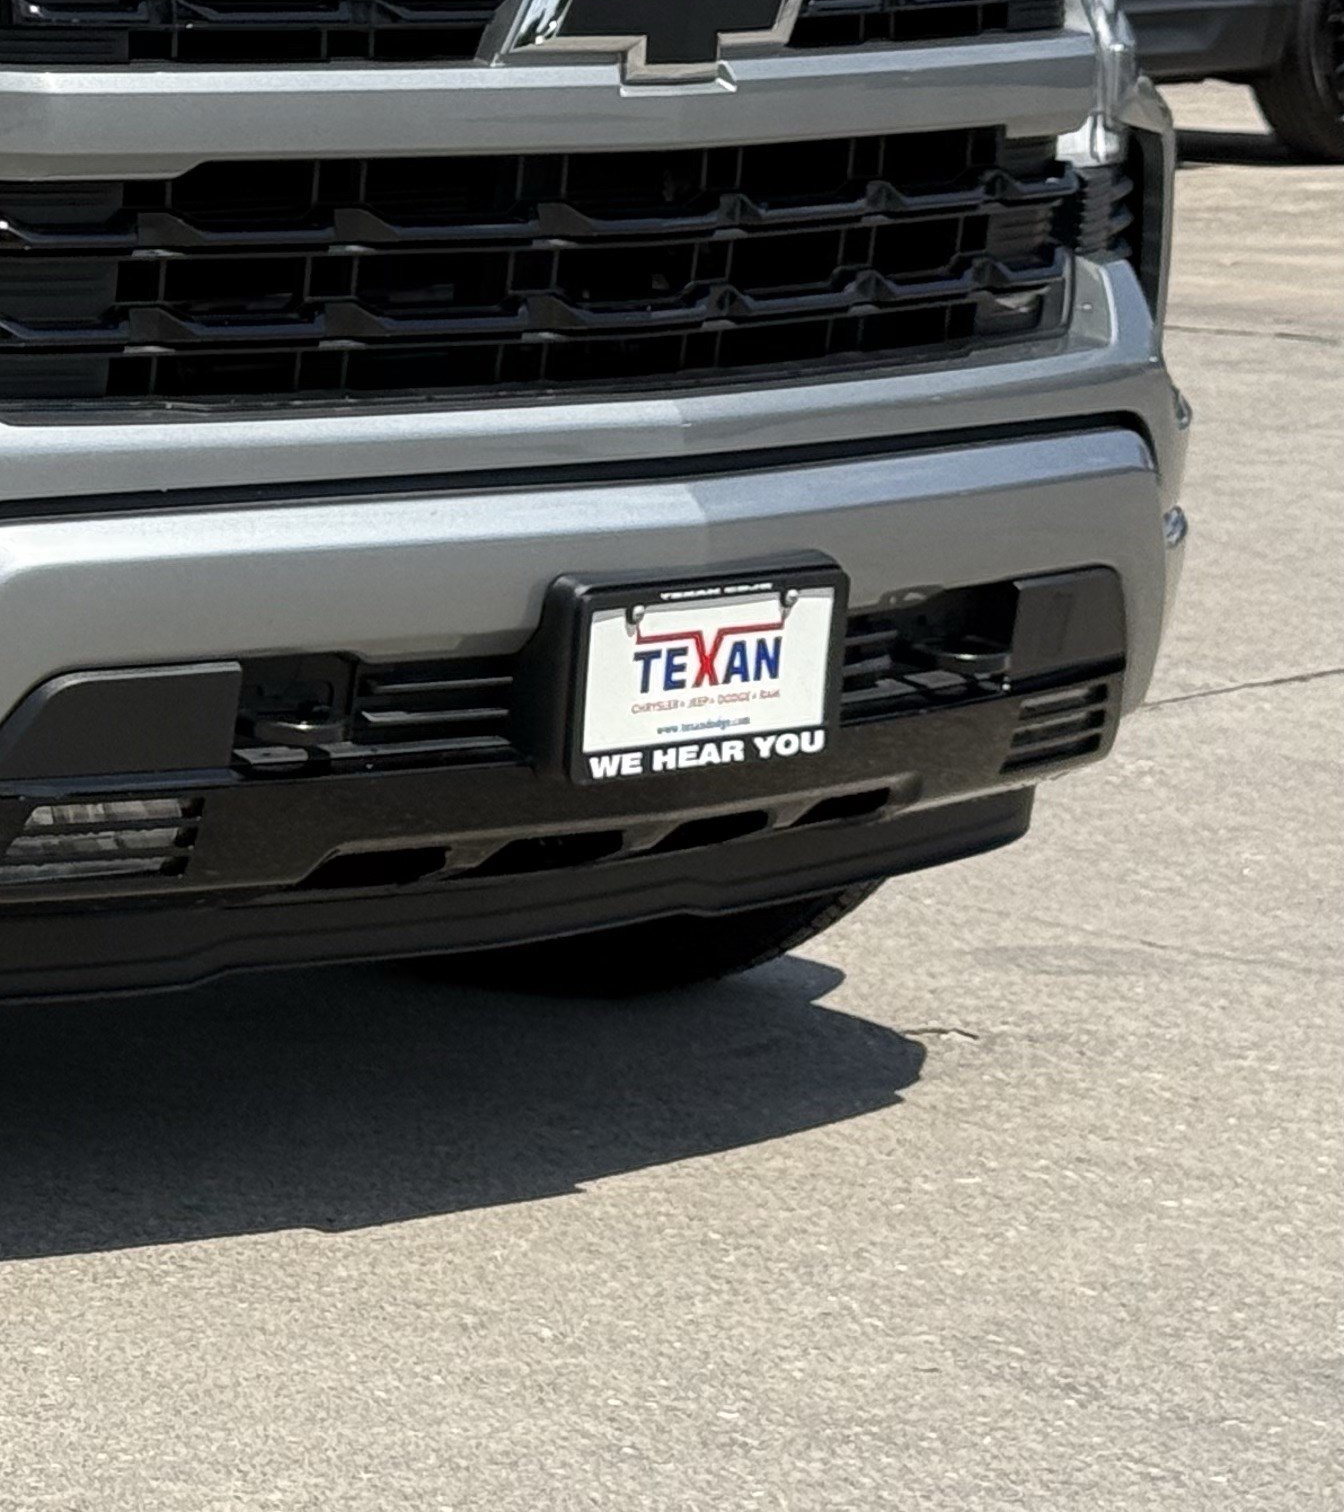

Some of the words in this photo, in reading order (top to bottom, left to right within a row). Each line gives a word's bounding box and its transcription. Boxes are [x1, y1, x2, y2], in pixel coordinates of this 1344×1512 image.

[633, 629, 783, 694] TEXAN
[631, 698, 679, 714] CHRYSLER
[687, 695, 710, 709] JEEP
[717, 691, 751, 705] DODGE
[588, 752, 643, 780] WE
[651, 739, 745, 772] HEAR
[752, 729, 826, 760] YOU
